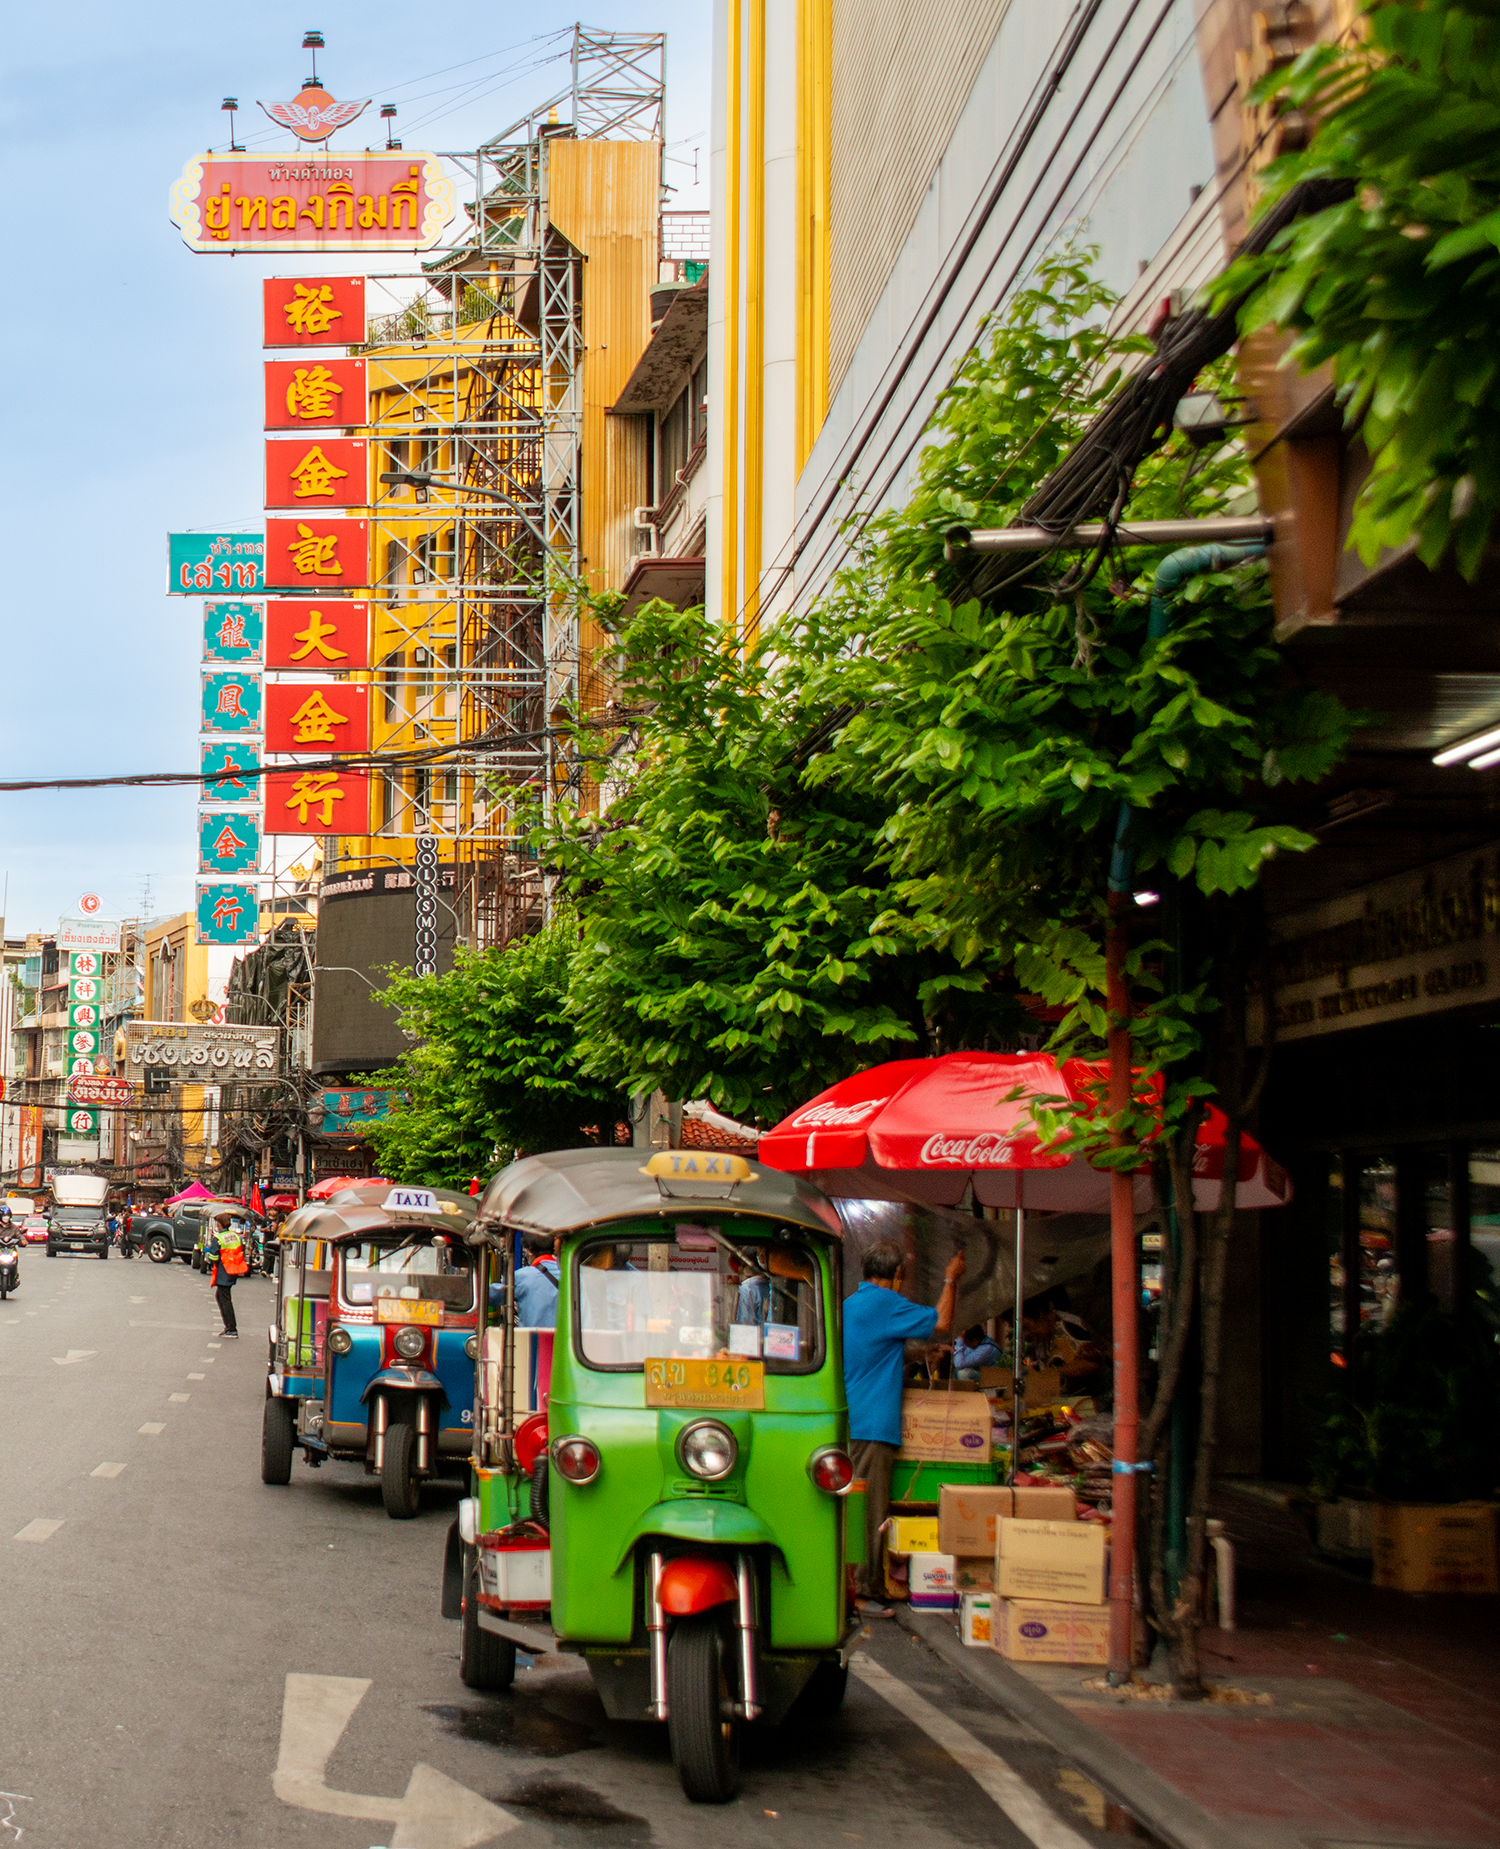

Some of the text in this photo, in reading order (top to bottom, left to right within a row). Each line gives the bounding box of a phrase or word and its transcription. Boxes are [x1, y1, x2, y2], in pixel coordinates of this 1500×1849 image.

[269, 162, 353, 181] ห้างค้าทอง
[206, 165, 419, 241] ยู่หลงกิมกี่
[180, 556, 264, 588] เล่งห
[211, 614, 249, 931] 龍鳳大金行
[792, 1096, 890, 1127] Coca-Cola
[920, 1132, 1015, 1164] Coca-Cola
[670, 1155, 731, 1175] TAXI
[395, 1193, 429, 1206] TAXI
[405, 1301, 437, 1314] 3716
[461, 1409, 474, 1423] 9
